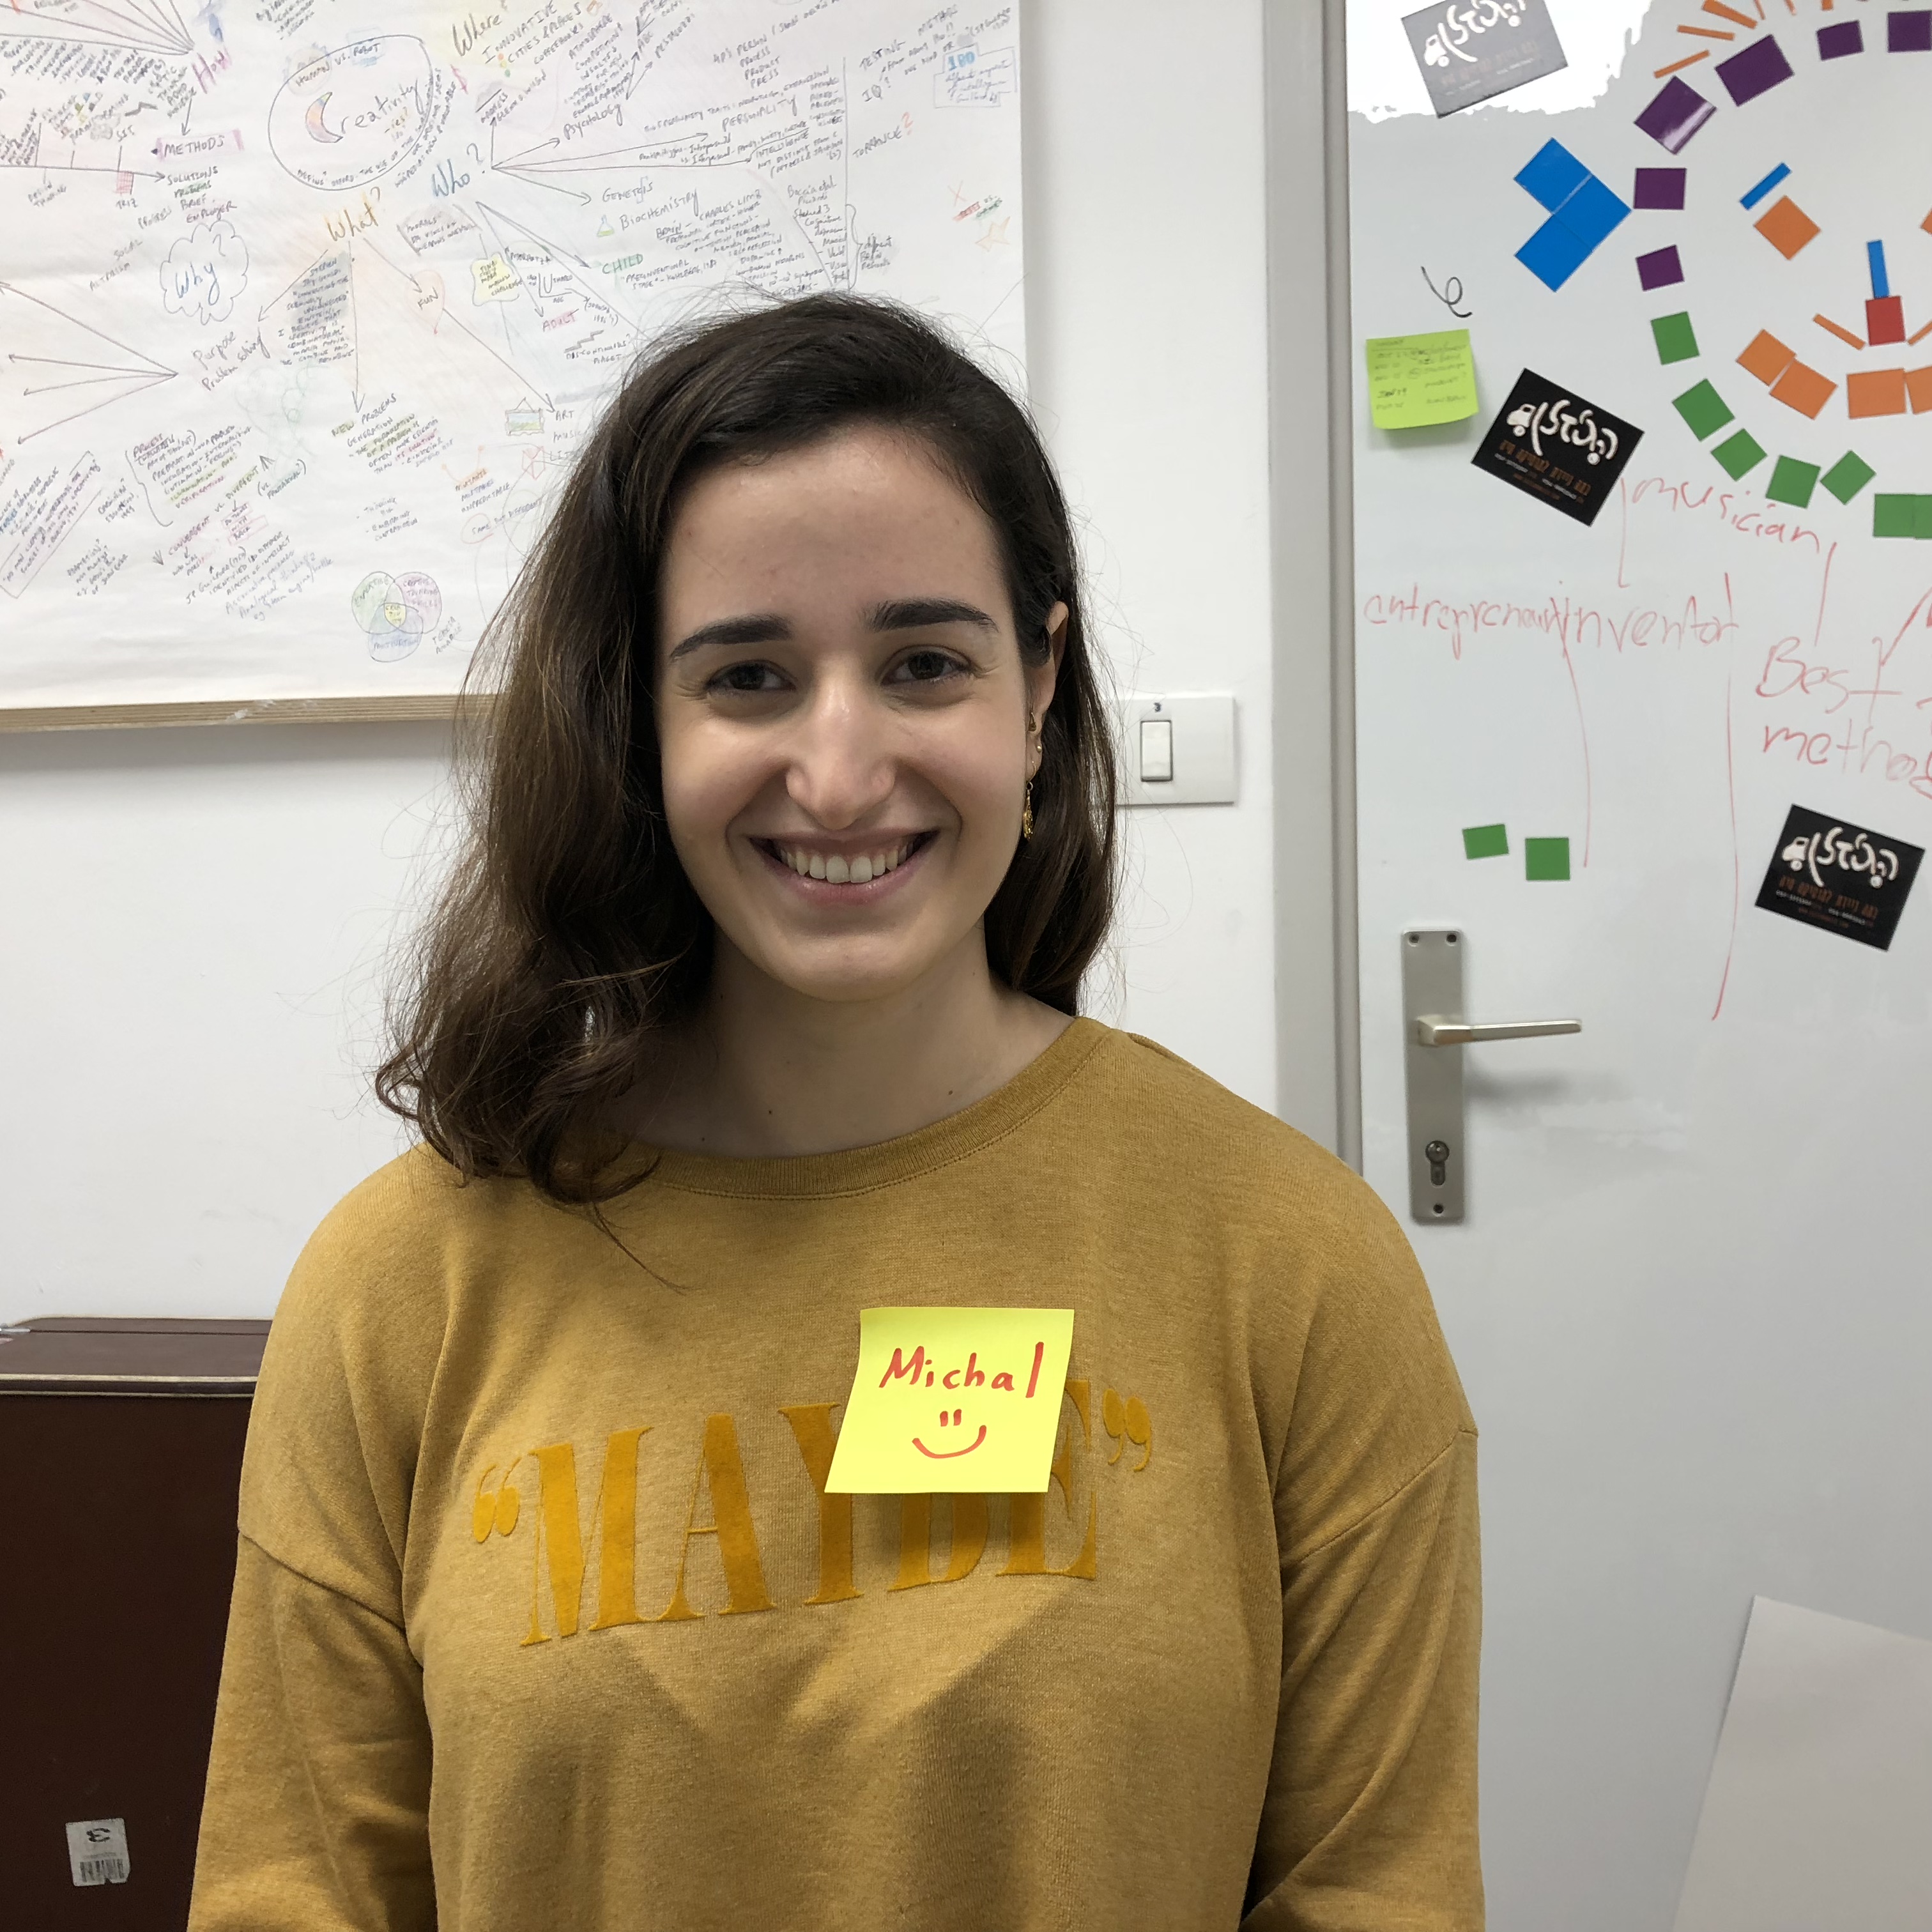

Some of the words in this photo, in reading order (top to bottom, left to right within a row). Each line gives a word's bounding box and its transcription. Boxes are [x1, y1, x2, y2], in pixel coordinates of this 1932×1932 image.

[164, 135, 225, 158] METHODS
[432, 158, 470, 197] Who
[602, 253, 644, 275] CHILD
[1632, 476, 1821, 554] musician
[1755, 636, 1903, 725] Best
[878, 1340, 1045, 1399] Michal
